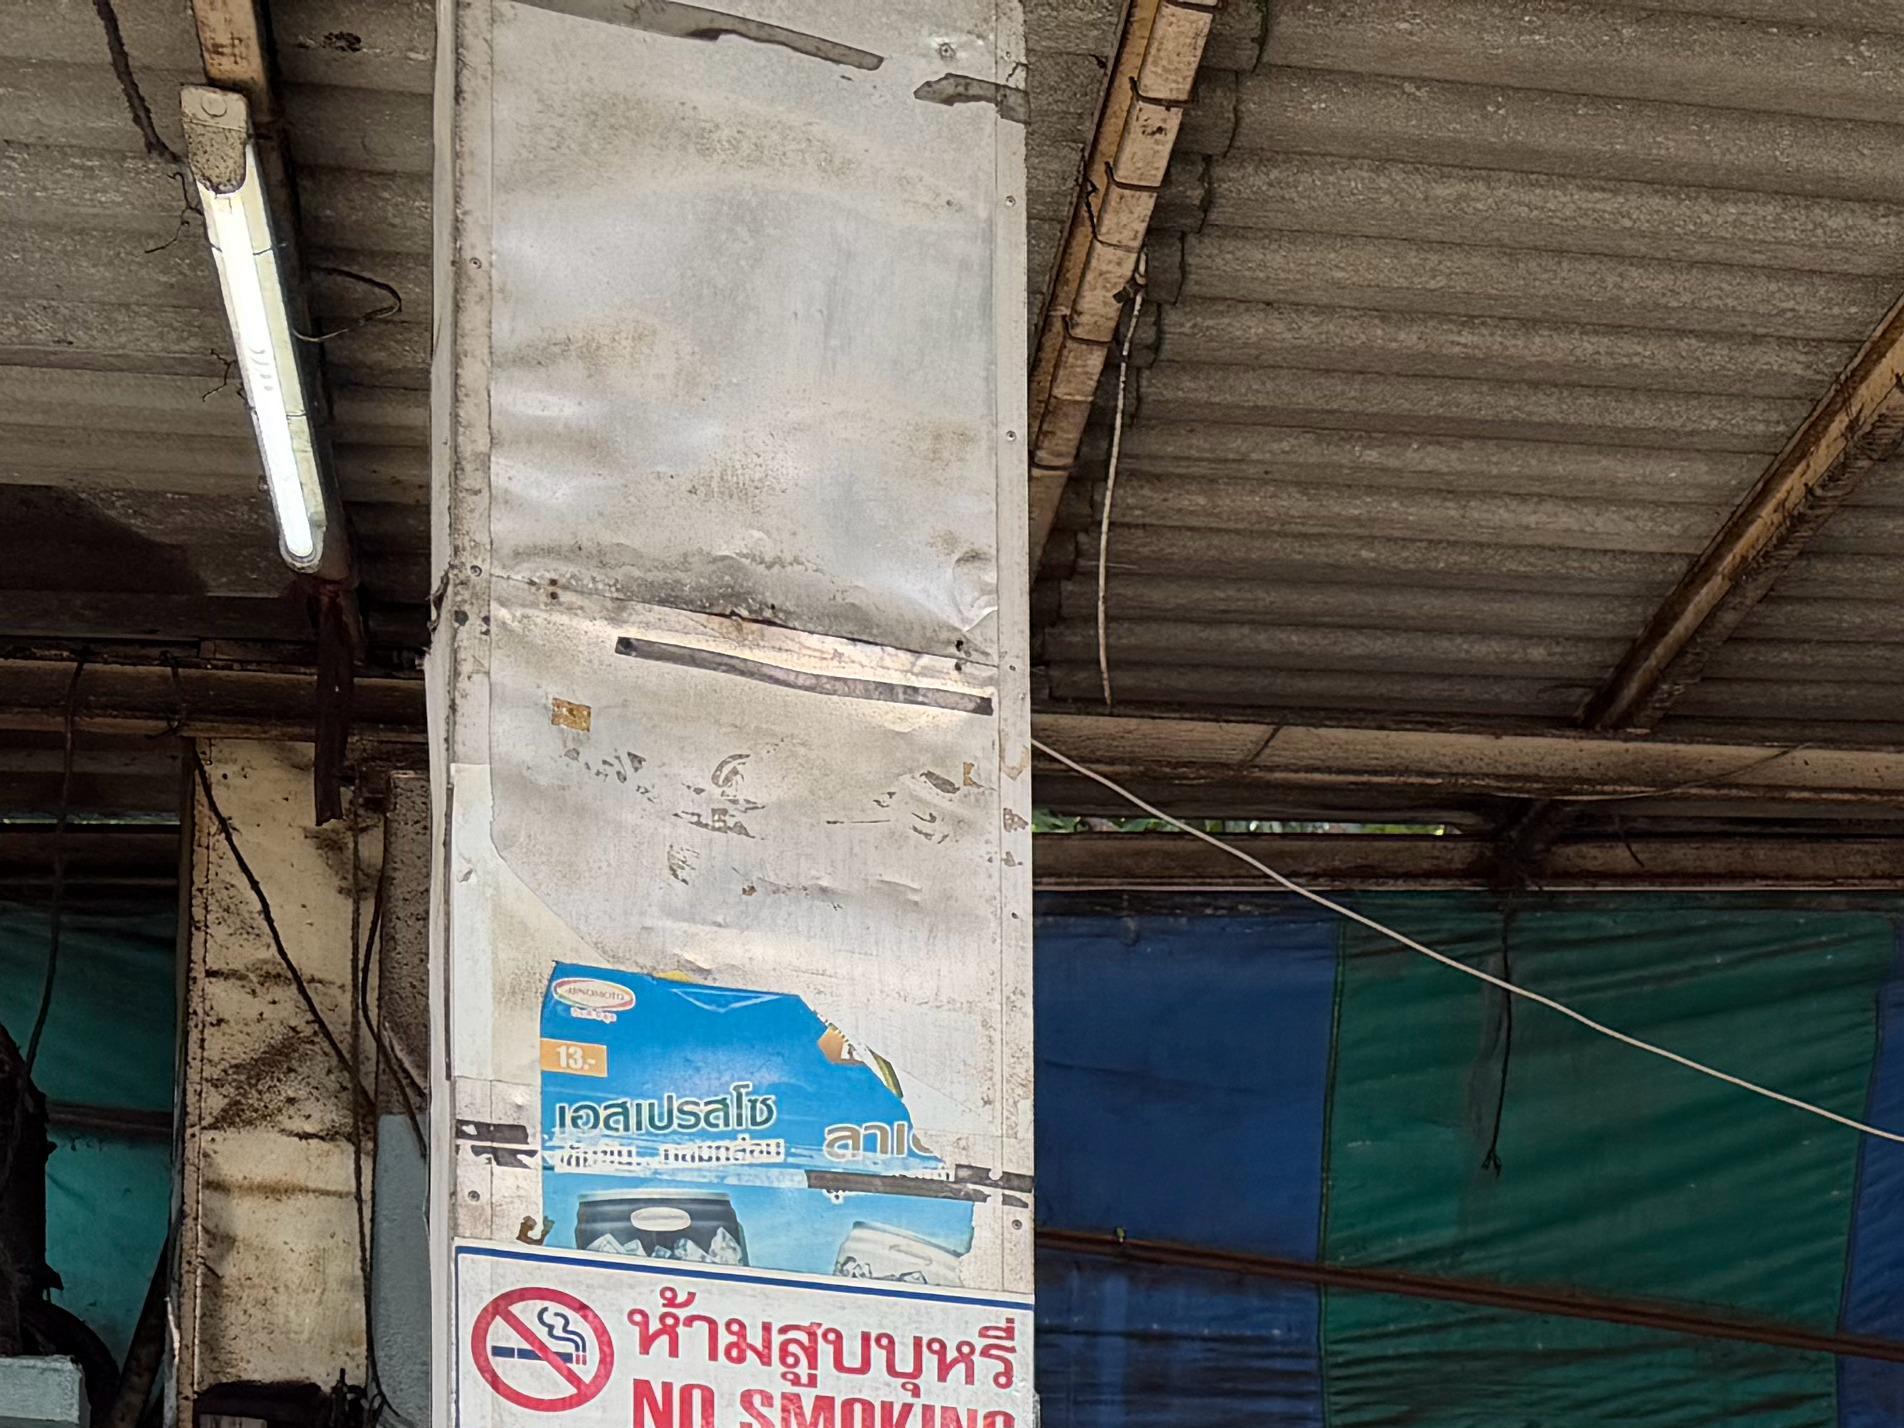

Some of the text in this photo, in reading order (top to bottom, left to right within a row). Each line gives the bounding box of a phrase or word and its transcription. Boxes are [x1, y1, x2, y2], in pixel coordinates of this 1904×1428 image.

[556, 1045, 596, 1069] 13.-
[557, 1083, 776, 1132] เอสเปรสโซ
[627, 1287, 1017, 1396] ห้ามสูบบุหรี่
